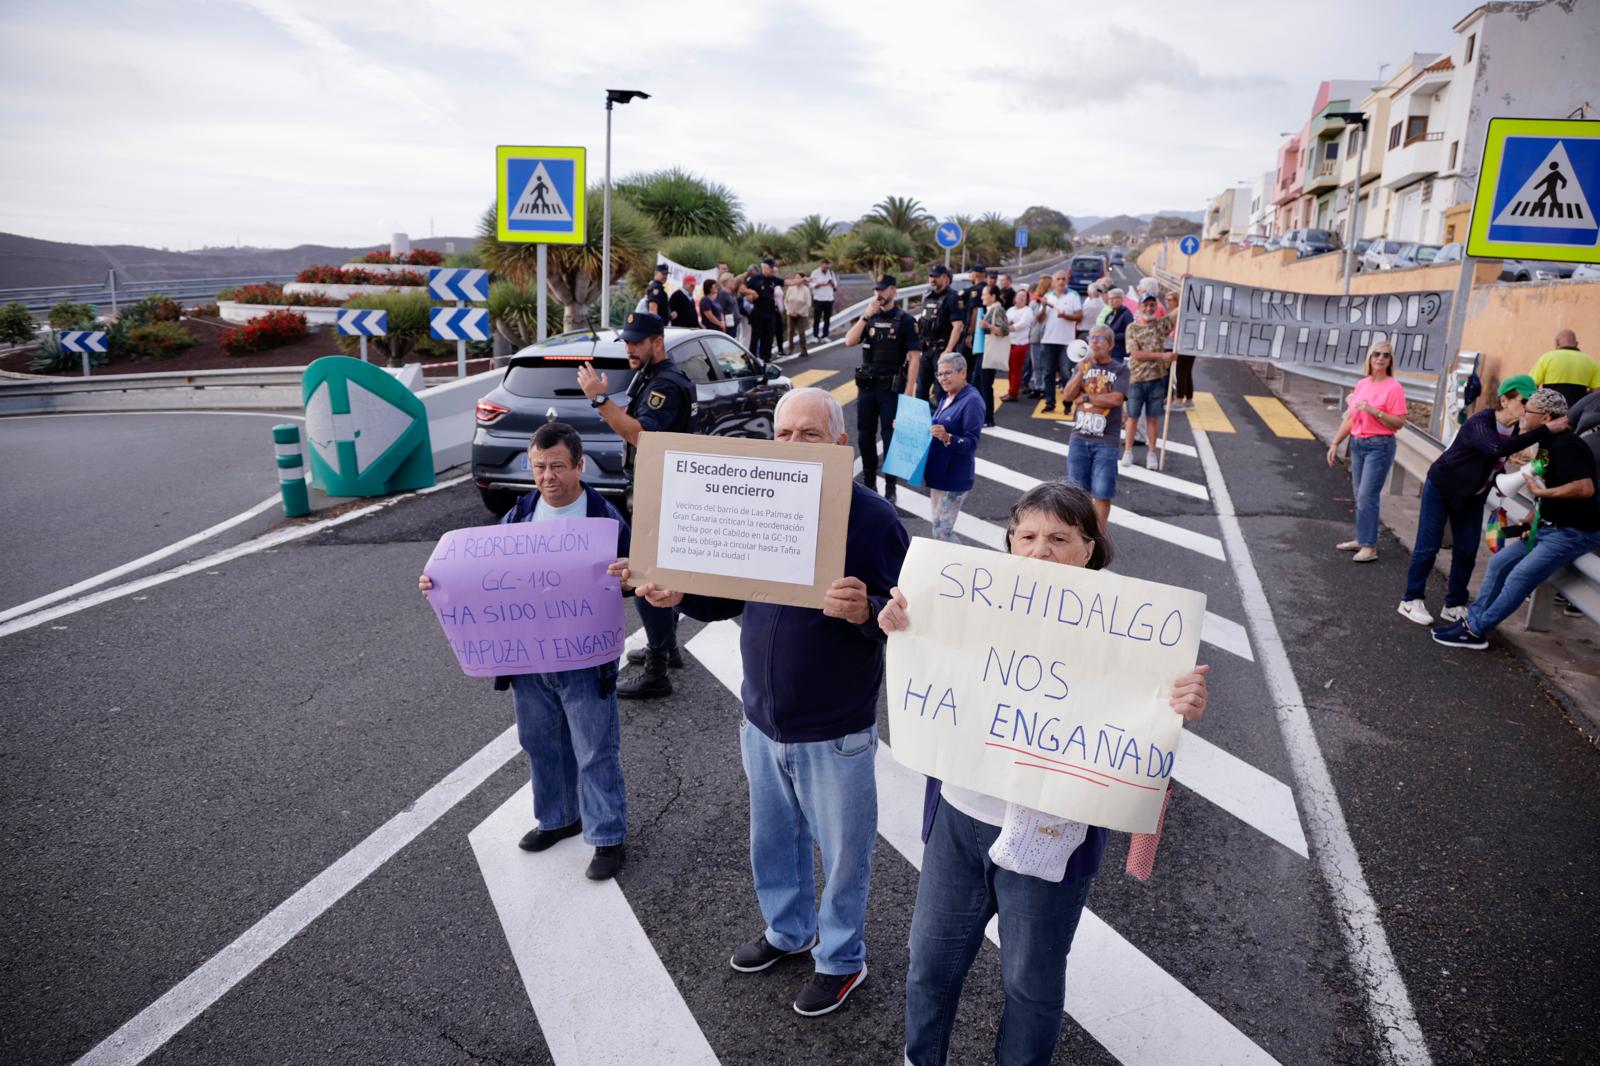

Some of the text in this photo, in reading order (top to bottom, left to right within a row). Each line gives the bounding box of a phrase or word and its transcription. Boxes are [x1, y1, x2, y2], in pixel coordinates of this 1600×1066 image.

[1220, 286, 1240, 318] AL
[1250, 288, 1315, 323] CARRIL
[1324, 294, 1421, 328] CABILDO
[1216, 320, 1286, 359] ACCESO
[1293, 327, 1310, 362] A
[1313, 328, 1340, 363] LA
[676, 460, 808, 483] El Secadero denuncia
[705, 482, 775, 498] su encierro
[672, 511, 804, 532] Gran Canaria critican la reordenación
[675, 501, 804, 521] Vecinos del barrio de Las Palmas de
[673, 536, 686, 546] que
[688, 535, 698, 544] les
[700, 537, 722, 548] obliga
[730, 539, 756, 551] circular
[758, 543, 779, 553] hasta
[781, 546, 801, 555] Tafira
[677, 524, 797, 543] hecha por el Cabildo en la GC-110
[670, 546, 687, 556] para
[688, 546, 705, 558] bajar
[713, 548, 720, 558] la
[721, 549, 745, 560] ciudad
[440, 605, 477, 625] HA
[545, 599, 593, 619] UNA
[534, 637, 545, 660] Y
[983, 646, 1069, 701] NOS
[904, 678, 1174, 779] HA ENGAÑADO
